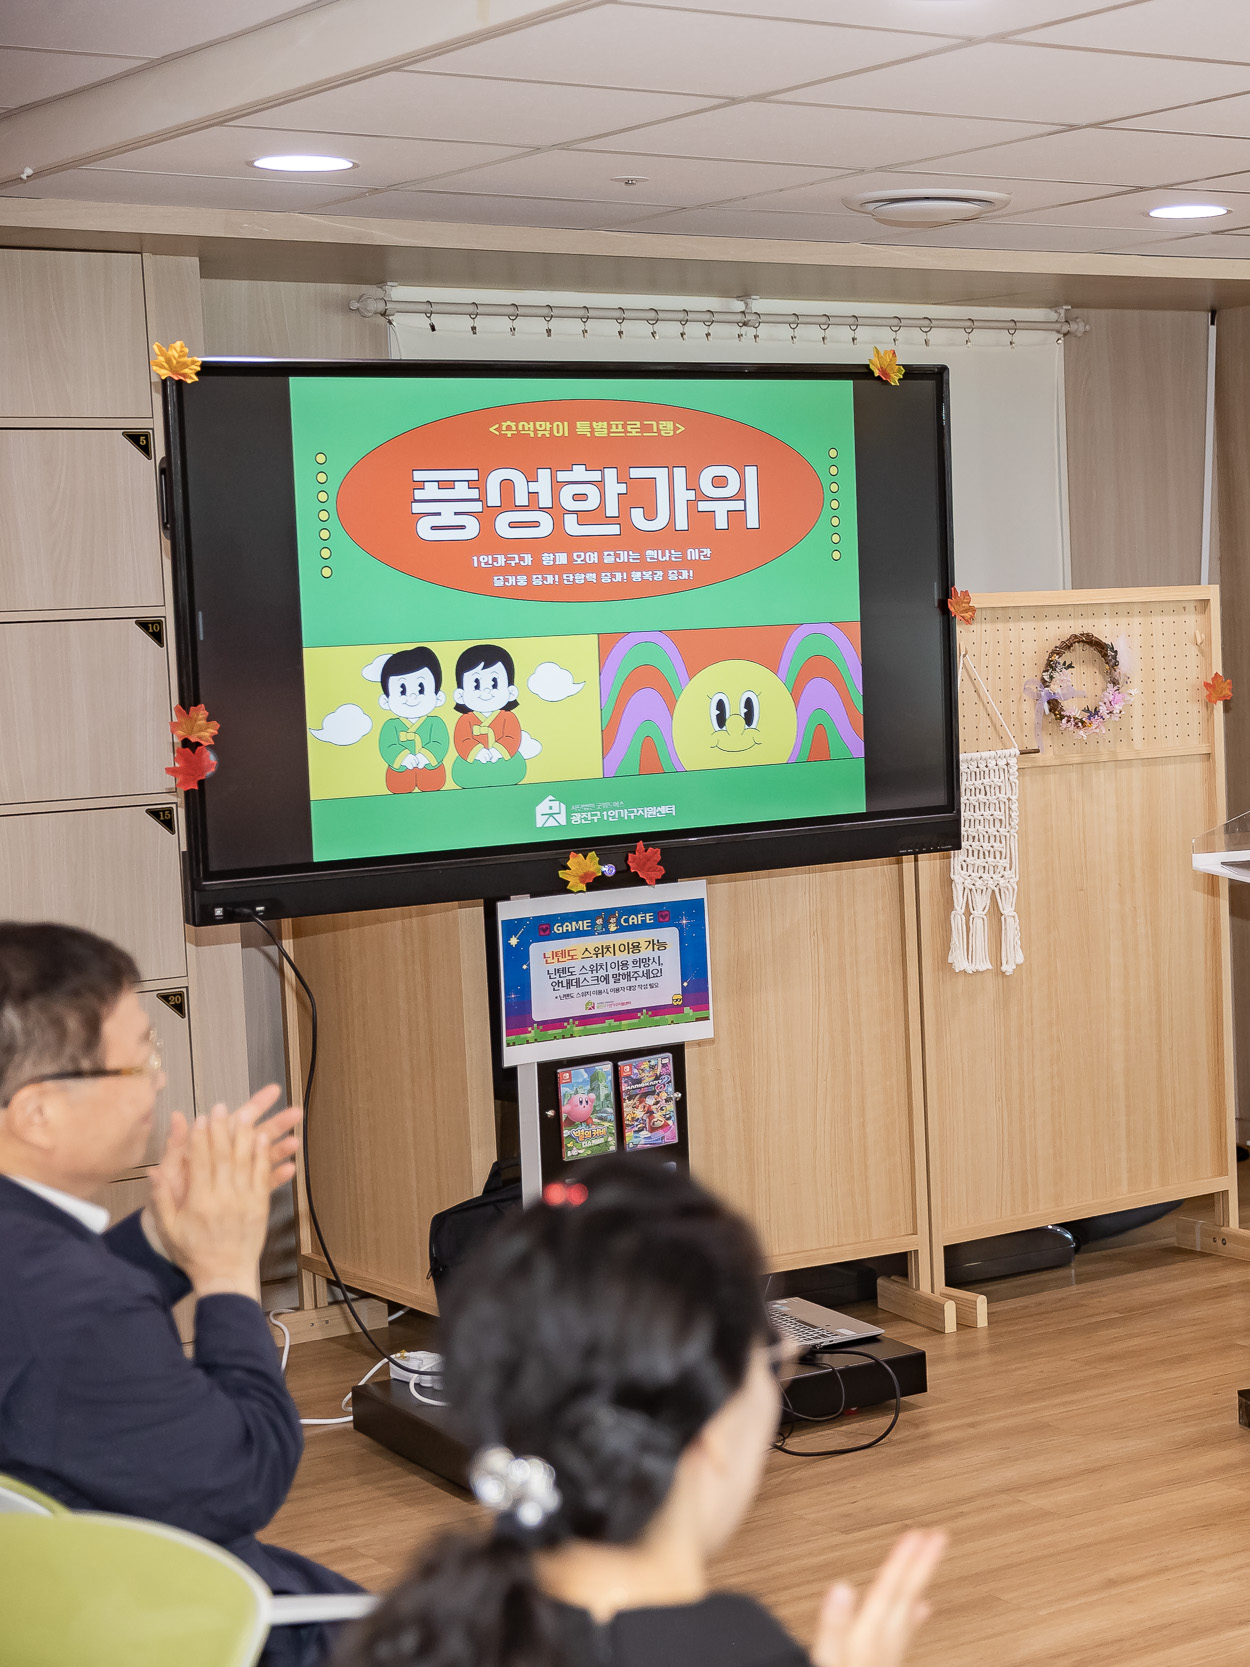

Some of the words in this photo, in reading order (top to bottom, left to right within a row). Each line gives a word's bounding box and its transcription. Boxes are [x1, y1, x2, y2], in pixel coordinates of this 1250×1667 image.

[489, 420, 569, 438] <추석맞이
[575, 420, 685, 437] 특별프로그램>
[140, 436, 147, 445] 5
[411, 464, 760, 542] 풍성한가위
[472, 552, 533, 568] 1인가구가
[541, 551, 568, 566] 함께
[573, 551, 599, 565] 모여
[602, 549, 641, 564] 즐기는
[687, 547, 712, 561] 시간
[493, 575, 528, 587] 즐거움
[532, 573, 559, 586] 증가!
[562, 572, 597, 585] 단합력
[600, 571, 627, 583] 증가!
[631, 570, 664, 582] 행복감
[668, 569, 694, 581] 증가!
[147, 623, 160, 632] 10
[159, 811, 171, 820] 15
[570, 811, 601, 825] 광진구
[602, 804, 676, 822] 1인가구지원센터
[553, 919, 592, 934] GAME
[620, 912, 654, 926] CAFE
[543, 948, 579, 965] 닌텐도
[580, 943, 616, 960] 스위치
[618, 941, 641, 955] 이용
[644, 938, 668, 952] 가능
[547, 965, 577, 980] 닌텐도
[579, 961, 608, 976] 스위치
[610, 959, 630, 971] 이용
[631, 955, 664, 969] 희망시,
[551, 974, 610, 992] 안내데스크에
[611, 967, 663, 984] 말해주세요!
[168, 995, 182, 1005] 20
[592, 1127, 607, 1138] 커비
